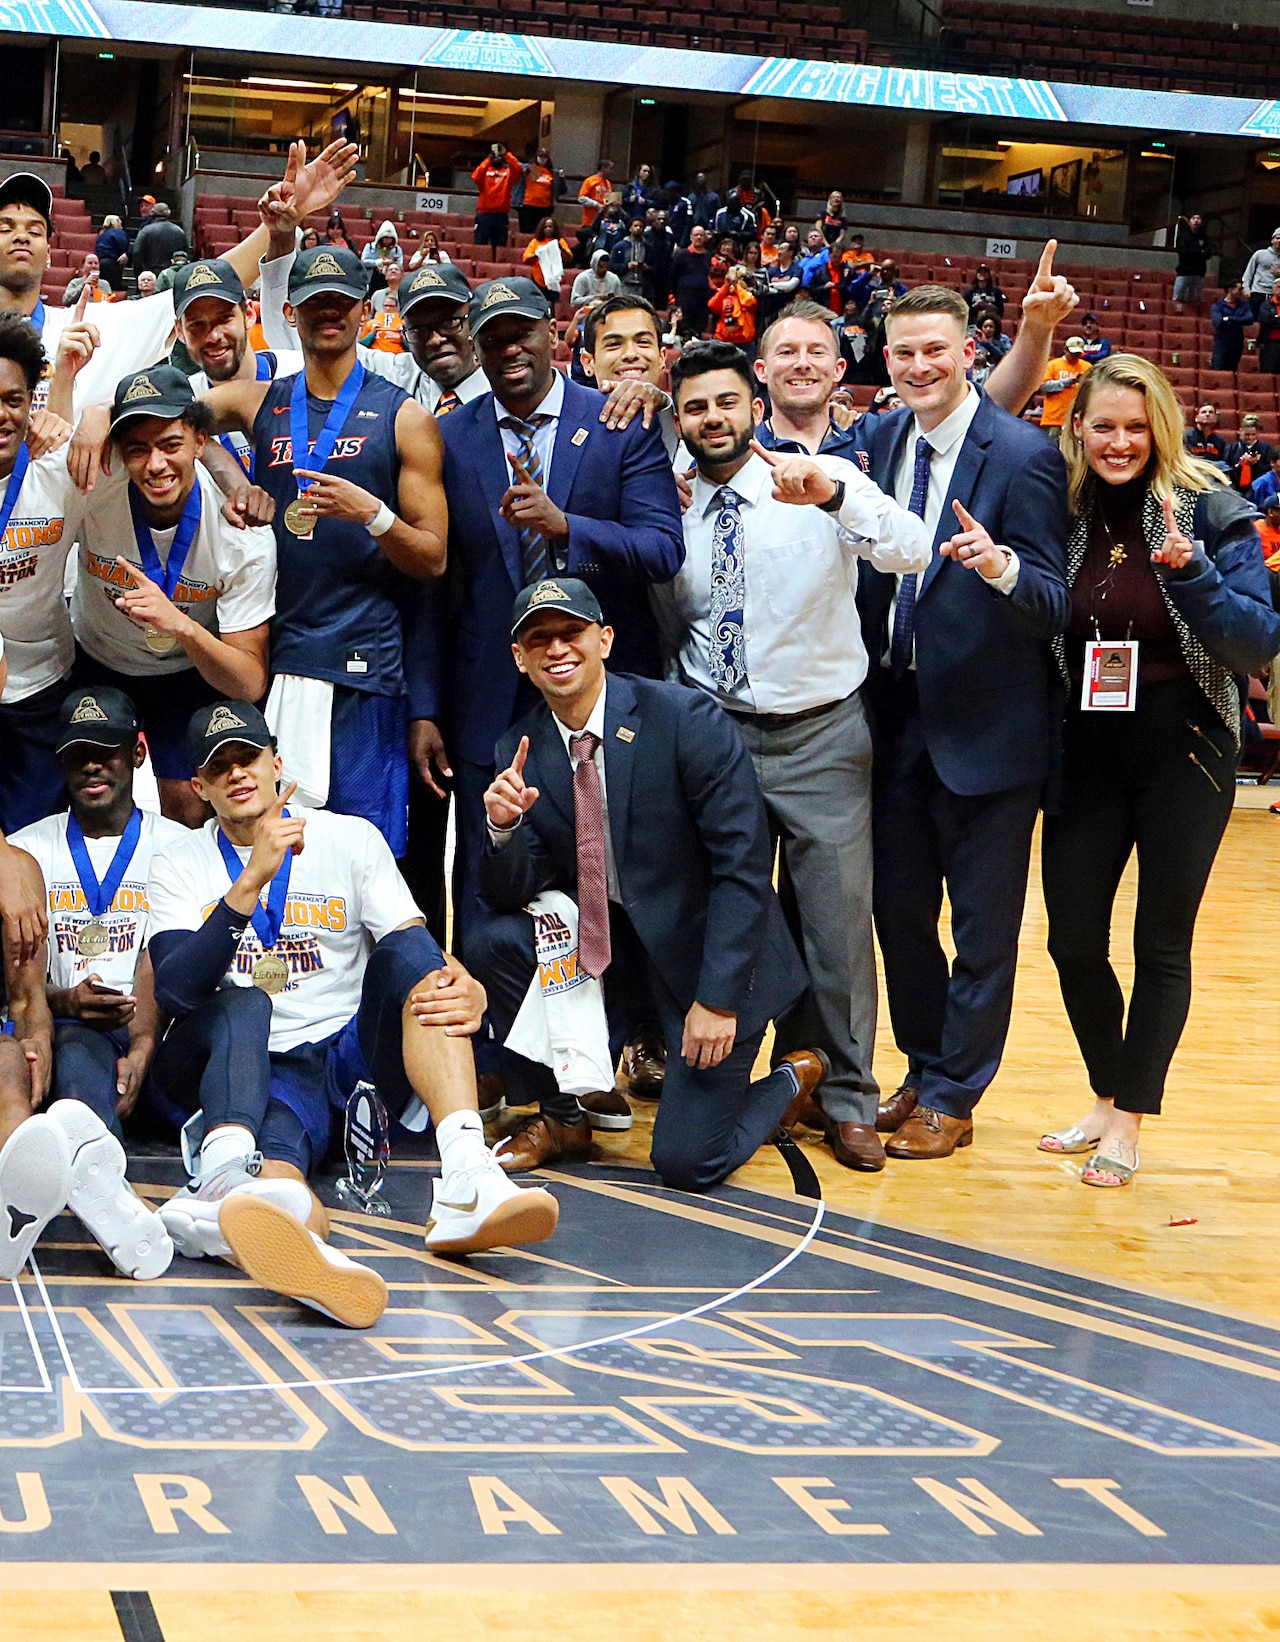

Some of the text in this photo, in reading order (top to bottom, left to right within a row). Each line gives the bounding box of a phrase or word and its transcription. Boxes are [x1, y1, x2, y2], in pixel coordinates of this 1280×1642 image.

[784, 59, 1019, 117] BIG WEST
[421, 198, 443, 210] 209
[992, 243, 1011, 255] 210
[384, 313, 395, 328] F
[354, 651, 361, 660] L
[287, 895, 324, 903] OURNAMENT
[55, 922, 80, 935] CAL
[544, 929, 572, 944] CAL
[537, 944, 557, 953] WEST
